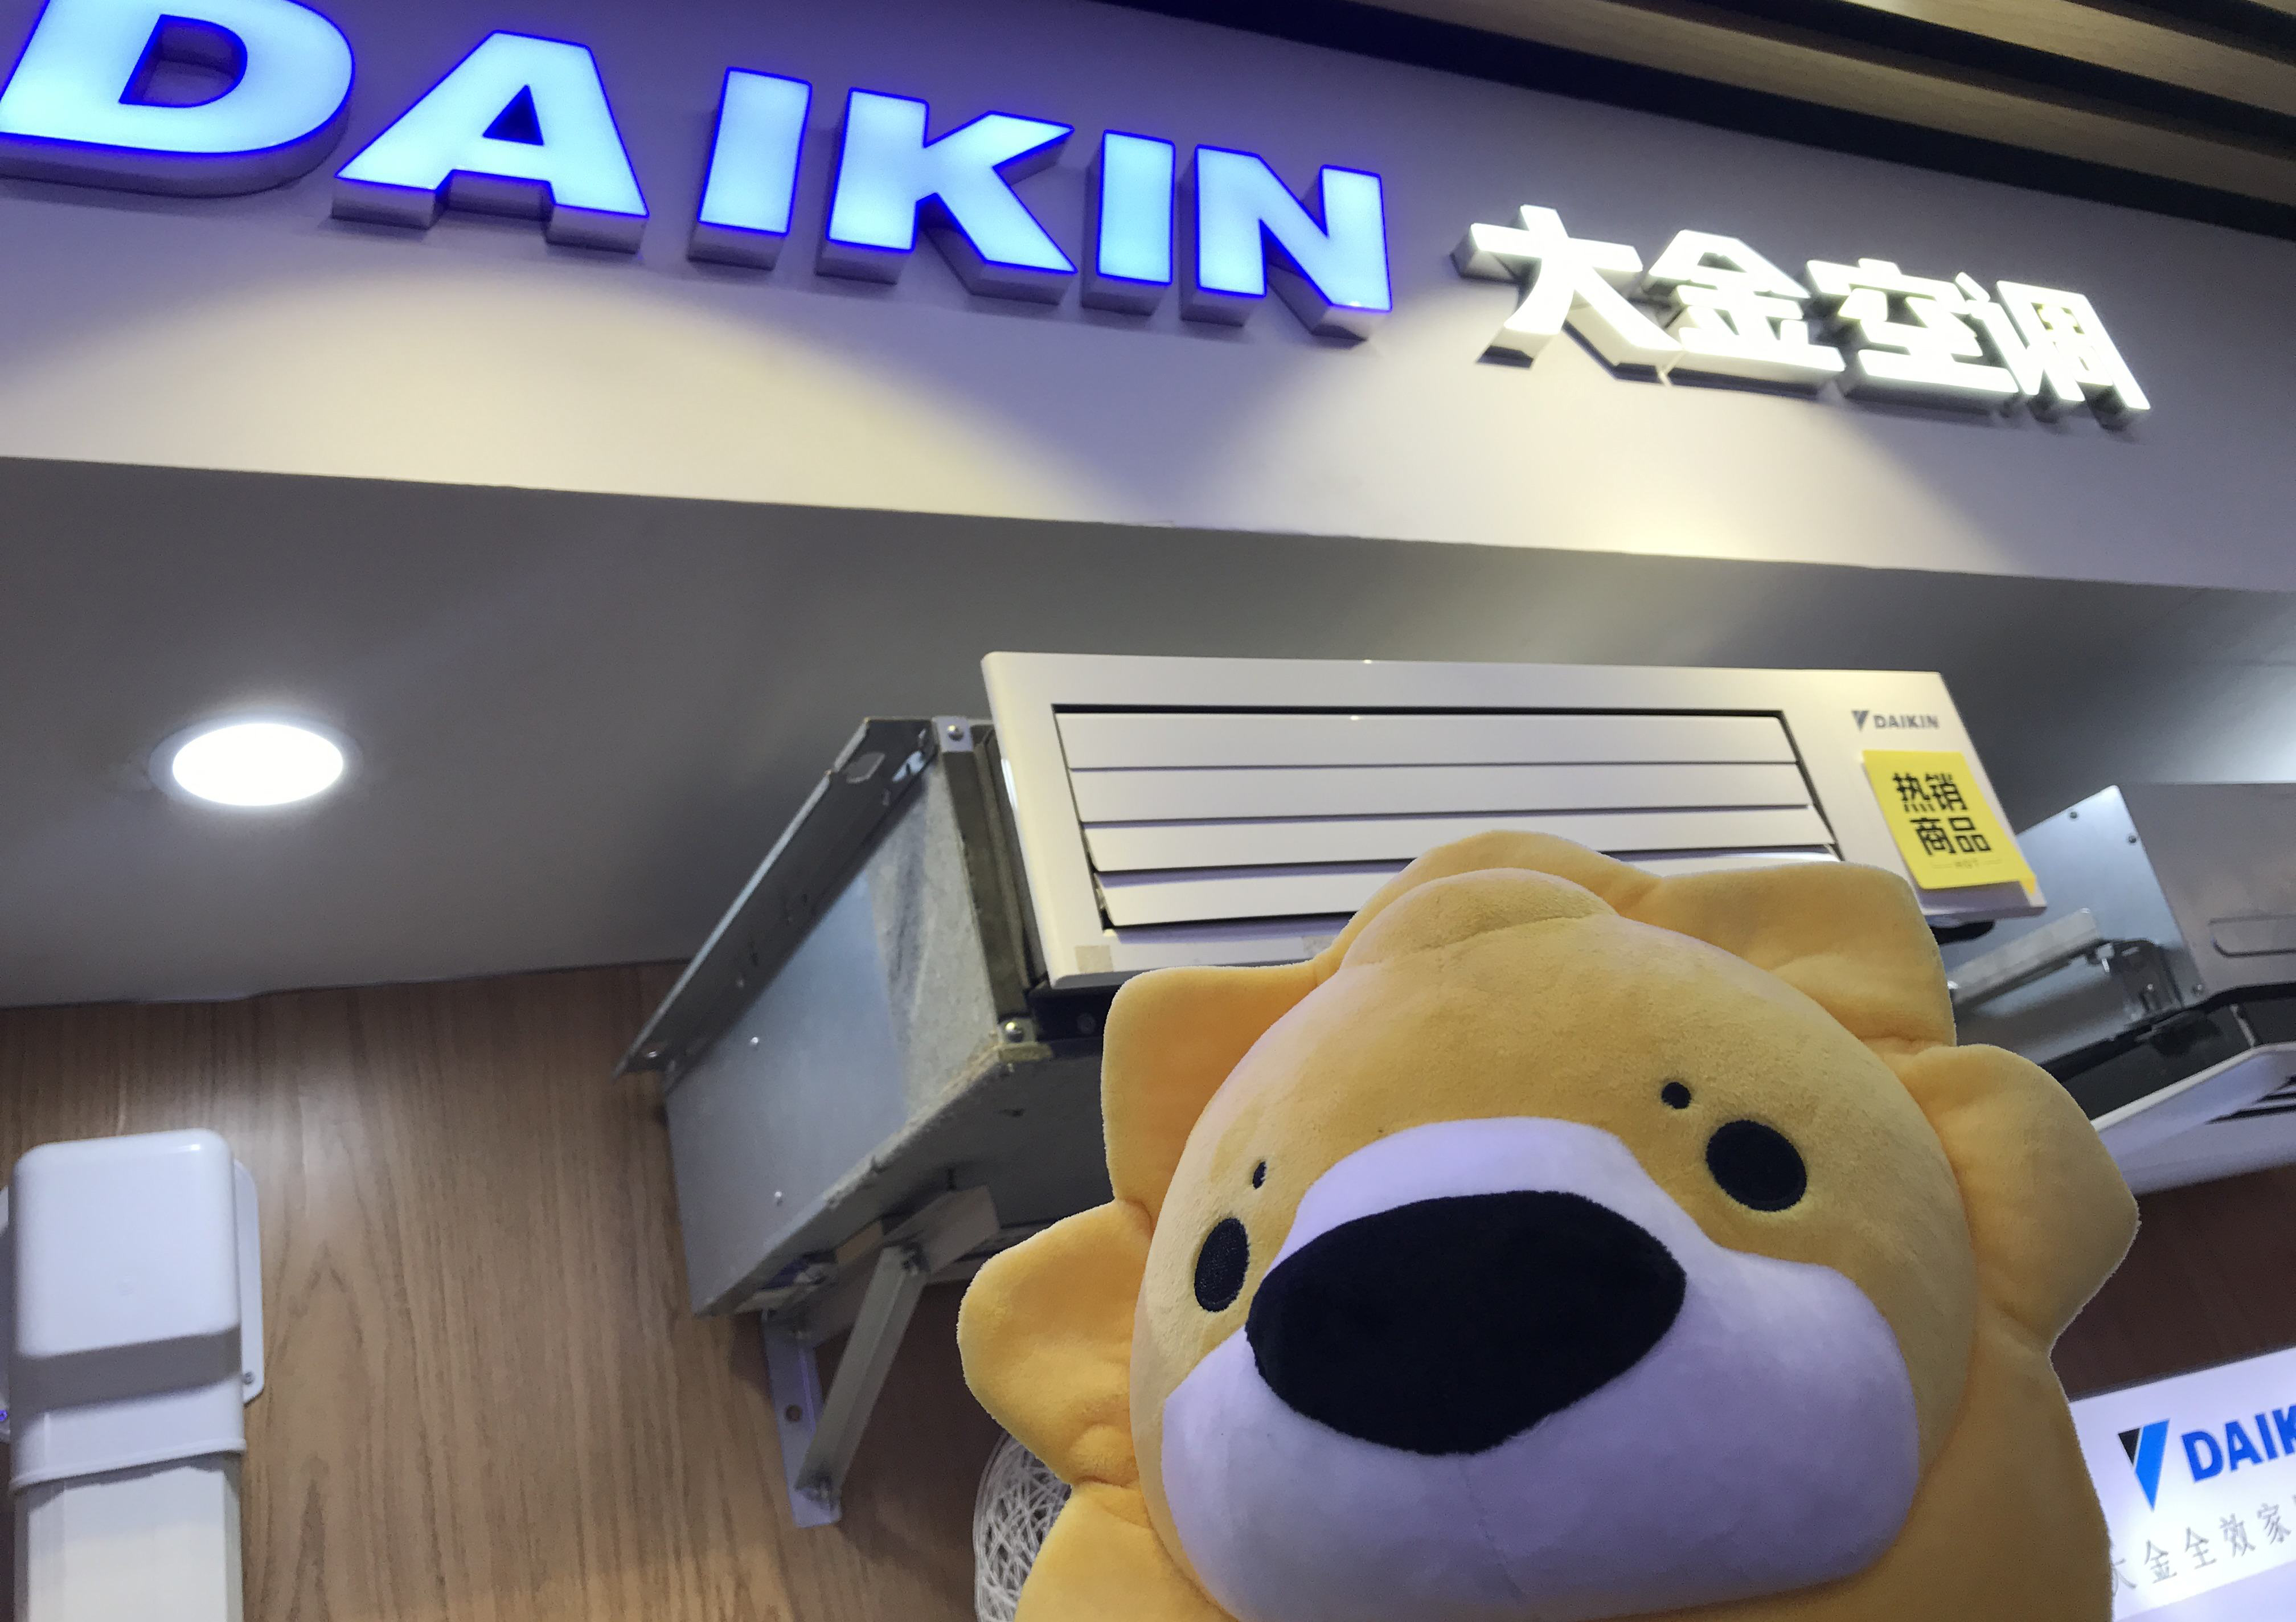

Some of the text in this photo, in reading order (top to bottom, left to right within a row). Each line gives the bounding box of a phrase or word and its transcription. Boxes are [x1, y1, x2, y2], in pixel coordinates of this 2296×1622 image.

[0, 0, 1392, 314] DAIKIN
[1467, 203, 2151, 411] 大金空调
[1873, 714, 1940, 730] DAIKIN
[1892, 772, 1969, 813] 热销
[1909, 817, 1992, 855] 商品
[2110, 1494, 2296, 1597] 大金全效家
